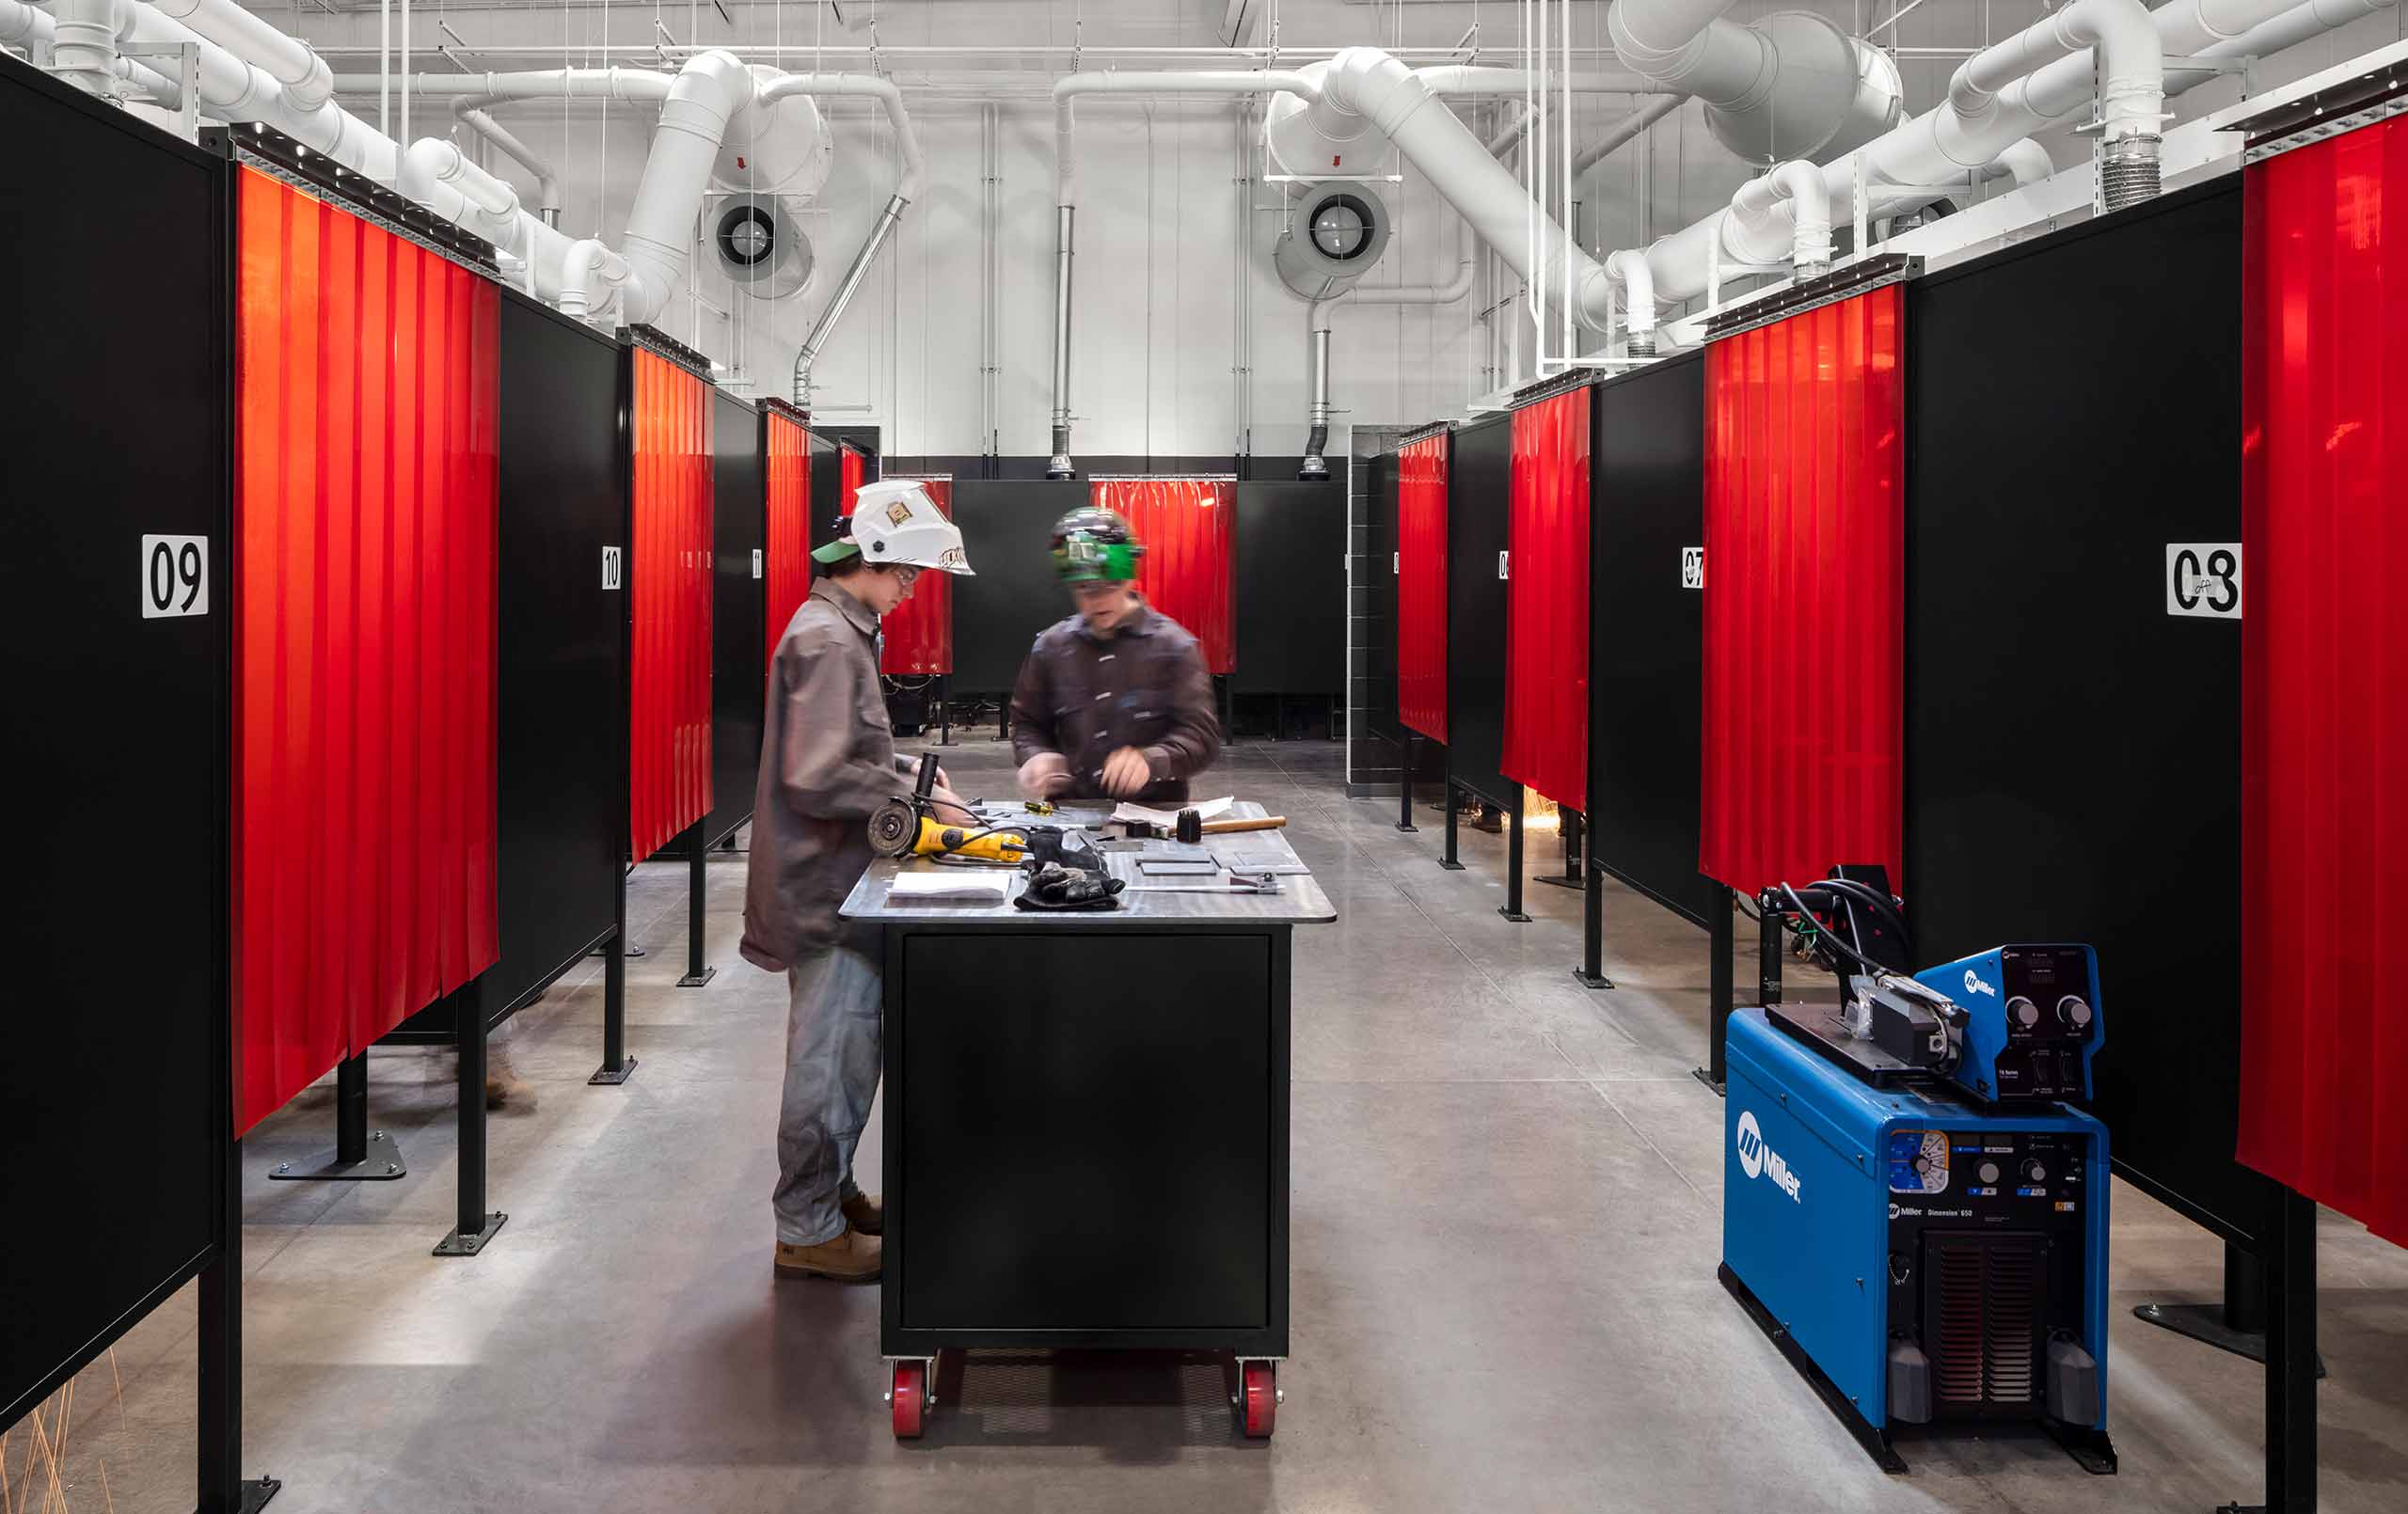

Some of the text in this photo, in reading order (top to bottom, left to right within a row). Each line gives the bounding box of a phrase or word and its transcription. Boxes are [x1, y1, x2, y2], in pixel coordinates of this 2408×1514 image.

[150, 542, 201, 613] 09
[605, 550, 618, 586] 10
[1976, 979, 1995, 997] Miller
[1764, 1144, 1800, 1202] Miller
[1901, 1207, 1923, 1216] Miller
[1927, 1208, 1958, 1217] Dimension
